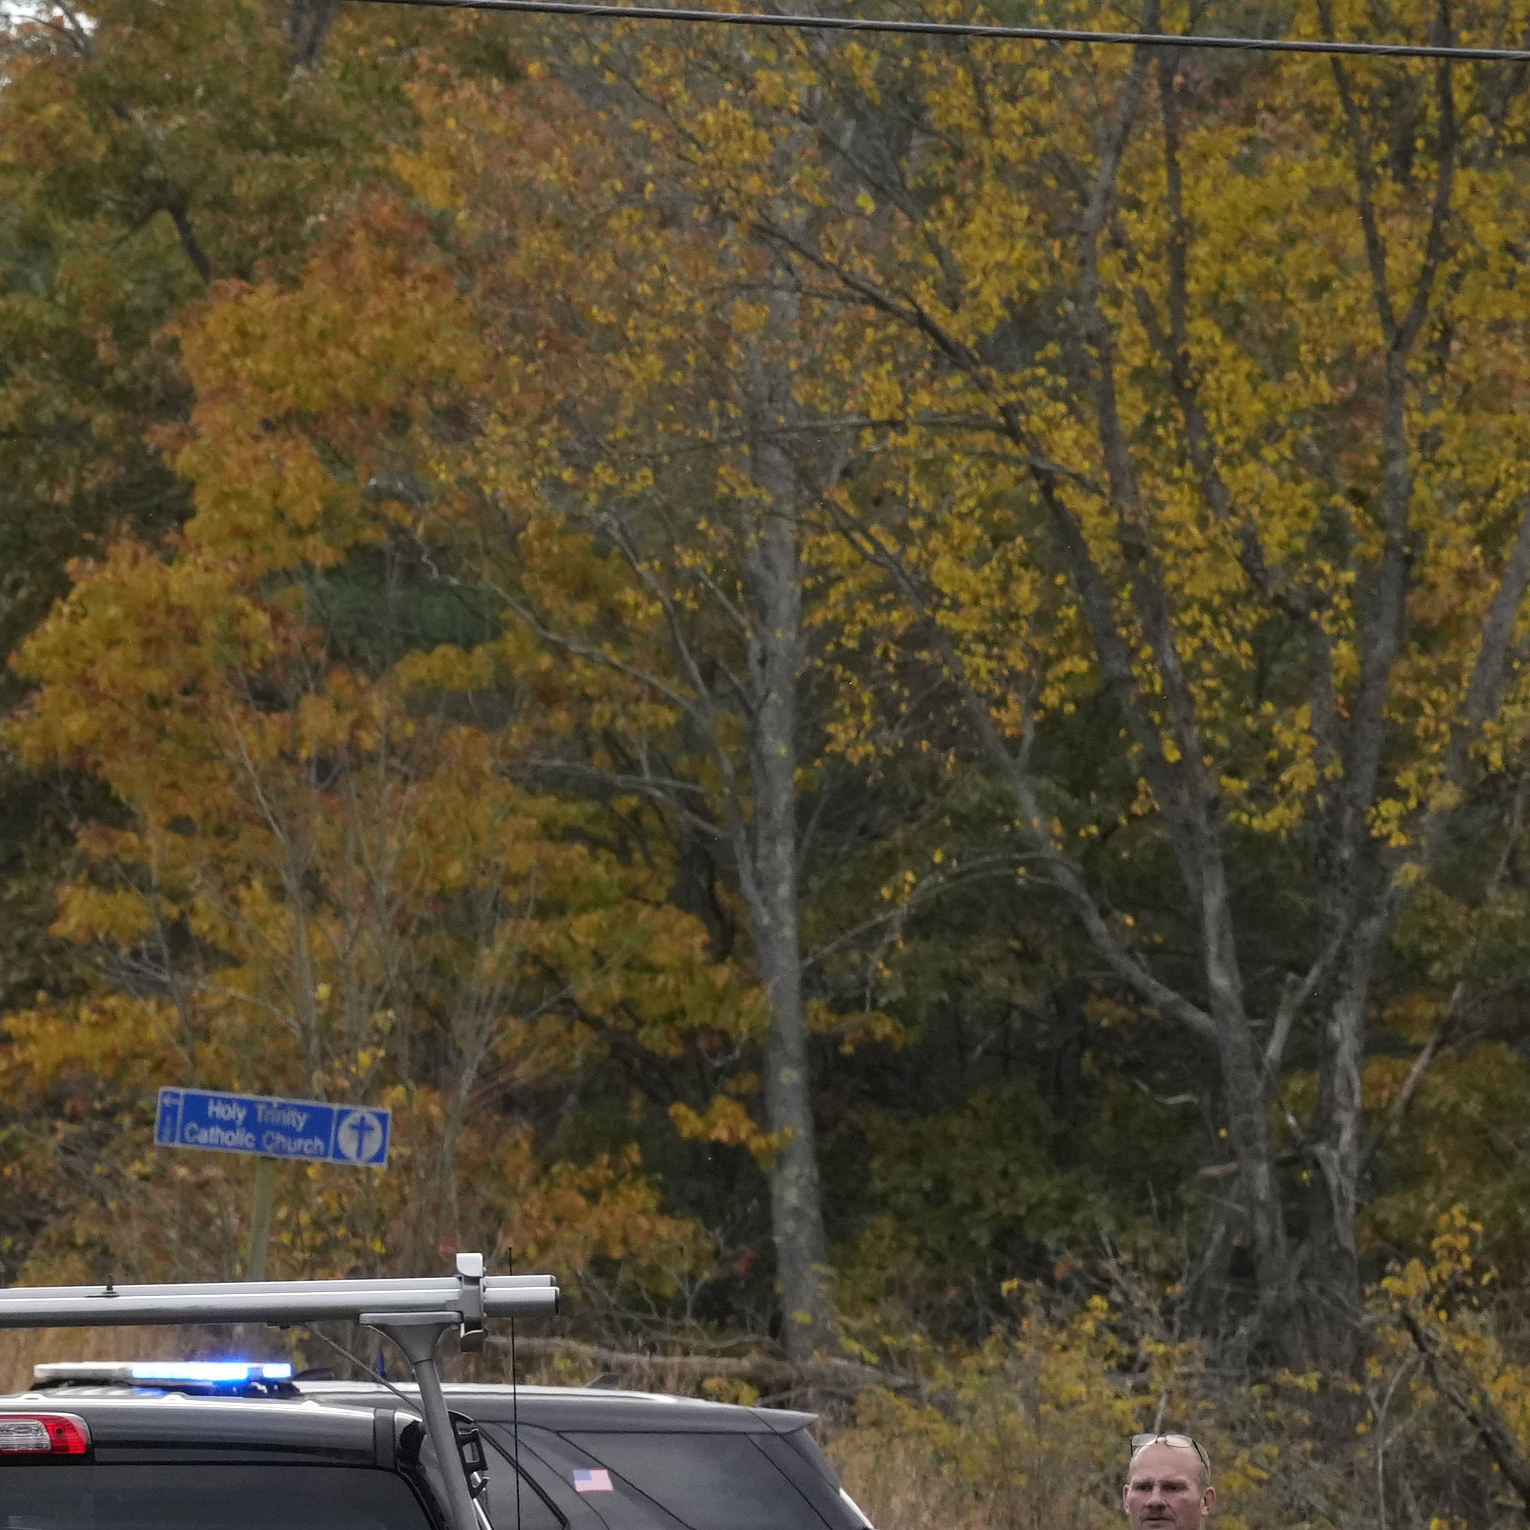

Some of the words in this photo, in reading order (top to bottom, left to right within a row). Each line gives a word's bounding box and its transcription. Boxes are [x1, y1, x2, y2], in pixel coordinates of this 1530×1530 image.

[207, 1098, 248, 1126] Holy
[256, 1100, 309, 1132] Trinity
[184, 1121, 256, 1149] Catholic
[262, 1130, 326, 1155] Church
